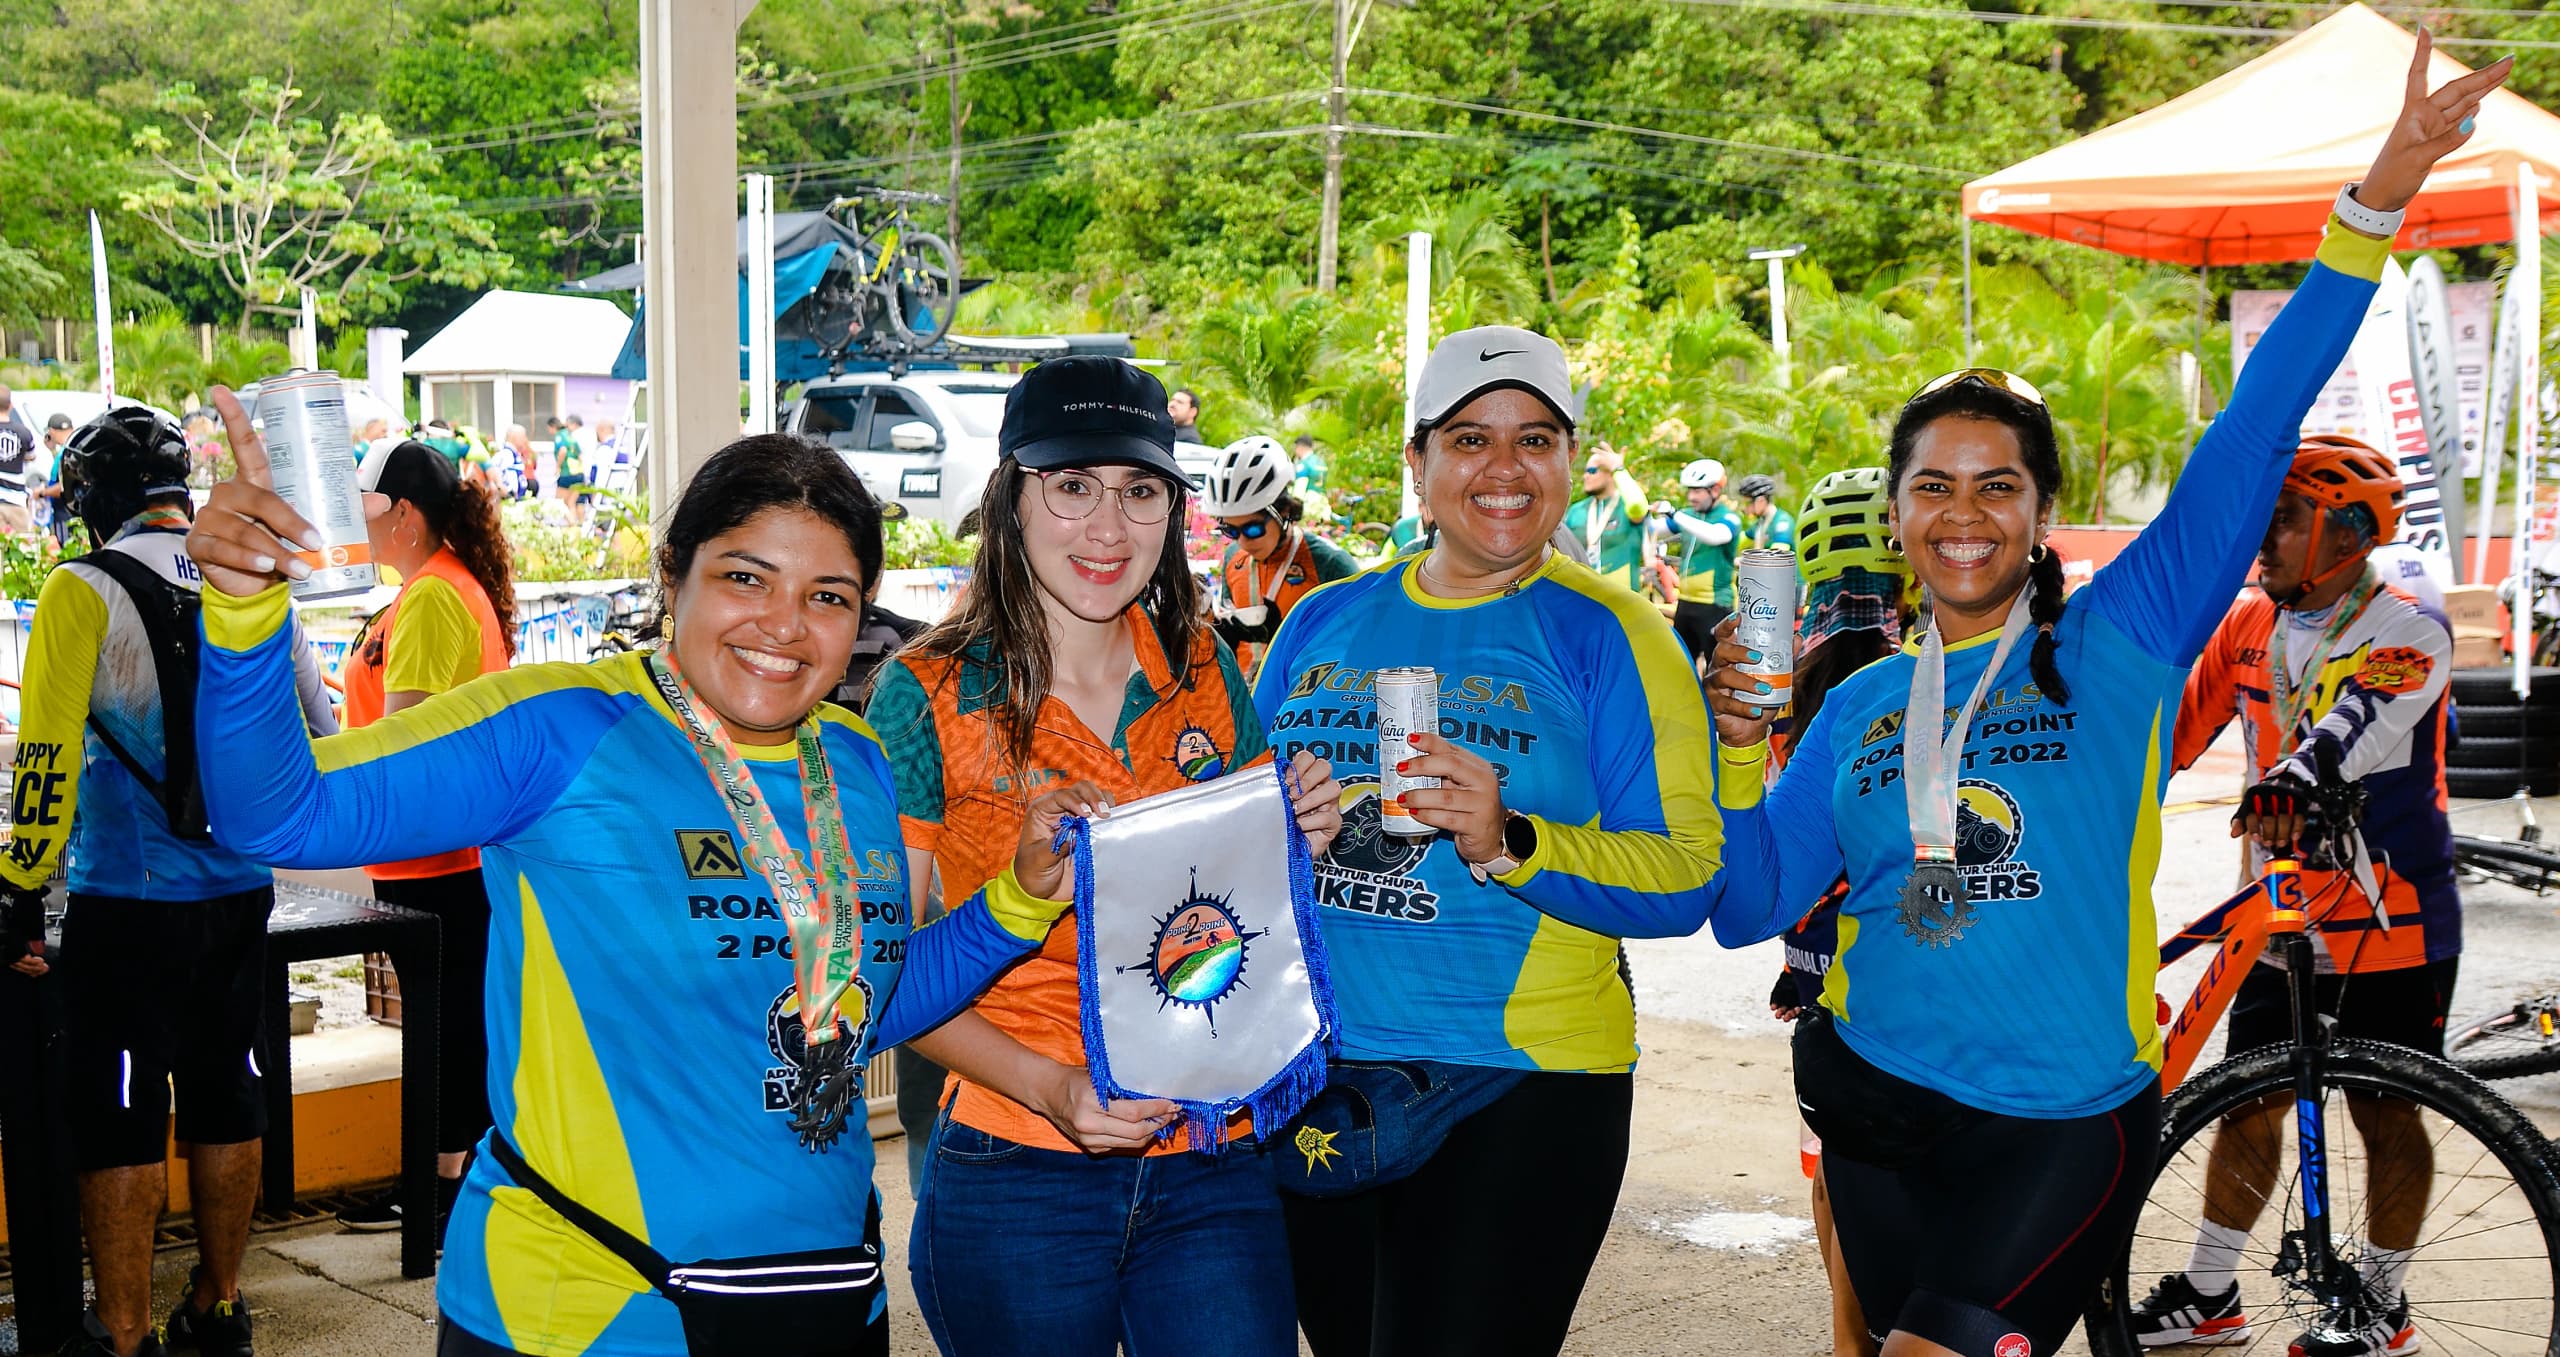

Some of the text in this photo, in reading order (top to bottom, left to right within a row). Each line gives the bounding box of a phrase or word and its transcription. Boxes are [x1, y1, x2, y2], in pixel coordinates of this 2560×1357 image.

[1062, 402, 1157, 421] TOMMY HILFIGER
[1381, 717, 1406, 742] Caña
[1439, 717, 1538, 755] OINT
[1982, 711, 2078, 740] POINT
[16, 741, 63, 771] APPY
[1286, 741, 1381, 765] POIN
[1858, 741, 2069, 797] 2 2022
[1189, 865, 1197, 876] N
[1313, 863, 1426, 892] DVENTUR CHUPA
[1982, 862, 2028, 874] CHUPA
[763, 855, 807, 918] 2022
[1314, 875, 1440, 922] IKERS
[1263, 926, 1272, 937] E
[716, 935, 741, 959] 2
[1115, 965, 1126, 976] W
[1210, 1029, 1219, 1040] S
